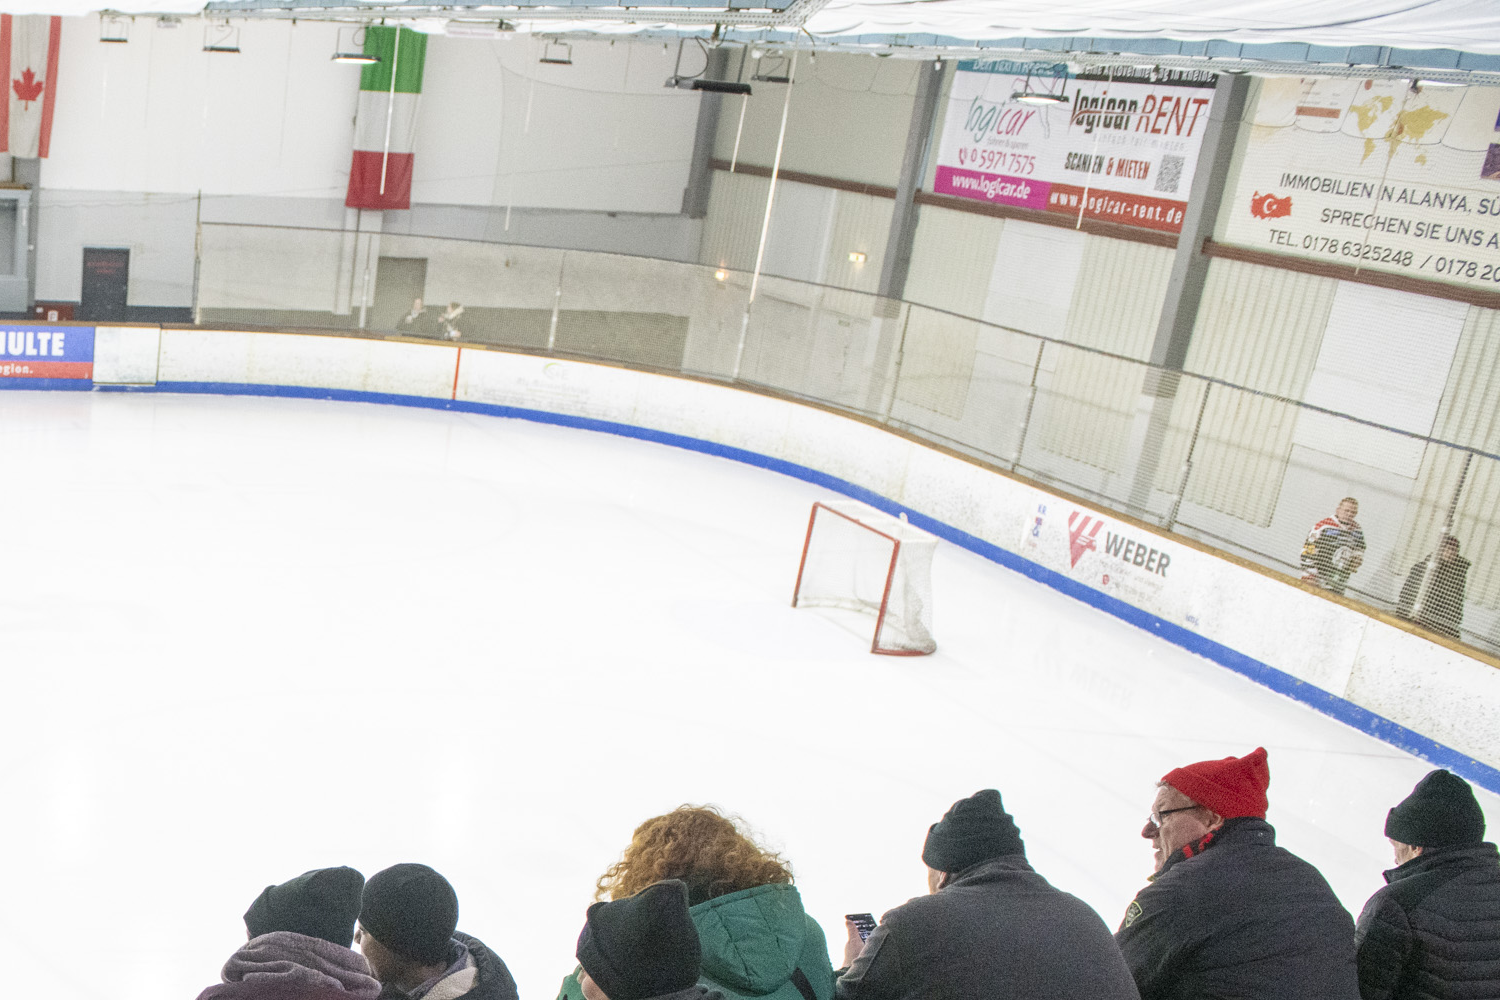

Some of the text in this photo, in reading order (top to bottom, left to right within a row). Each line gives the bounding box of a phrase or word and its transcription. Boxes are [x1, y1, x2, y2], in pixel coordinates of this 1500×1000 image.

[964, 95, 1037, 143] logicar
[1071, 88, 1210, 138] logicar RENT
[952, 175, 1031, 199] www.logicar.de
[1106, 157, 1114, 176] &
[1115, 158, 1152, 181] MIETEN
[1279, 172, 1375, 199] IMMOBILIEN
[1320, 208, 1412, 236] SPRECHEN
[1413, 220, 1444, 240] SIE
[1445, 225, 1483, 250] UNS
[1269, 229, 1298, 247] TEL.
[1303, 234, 1339, 254] 0178
[1341, 241, 1414, 267] 6325248
[1418, 254, 1434, 270] /
[1435, 256, 1478, 279] 0178
[1105, 531, 1172, 578] WEBER
